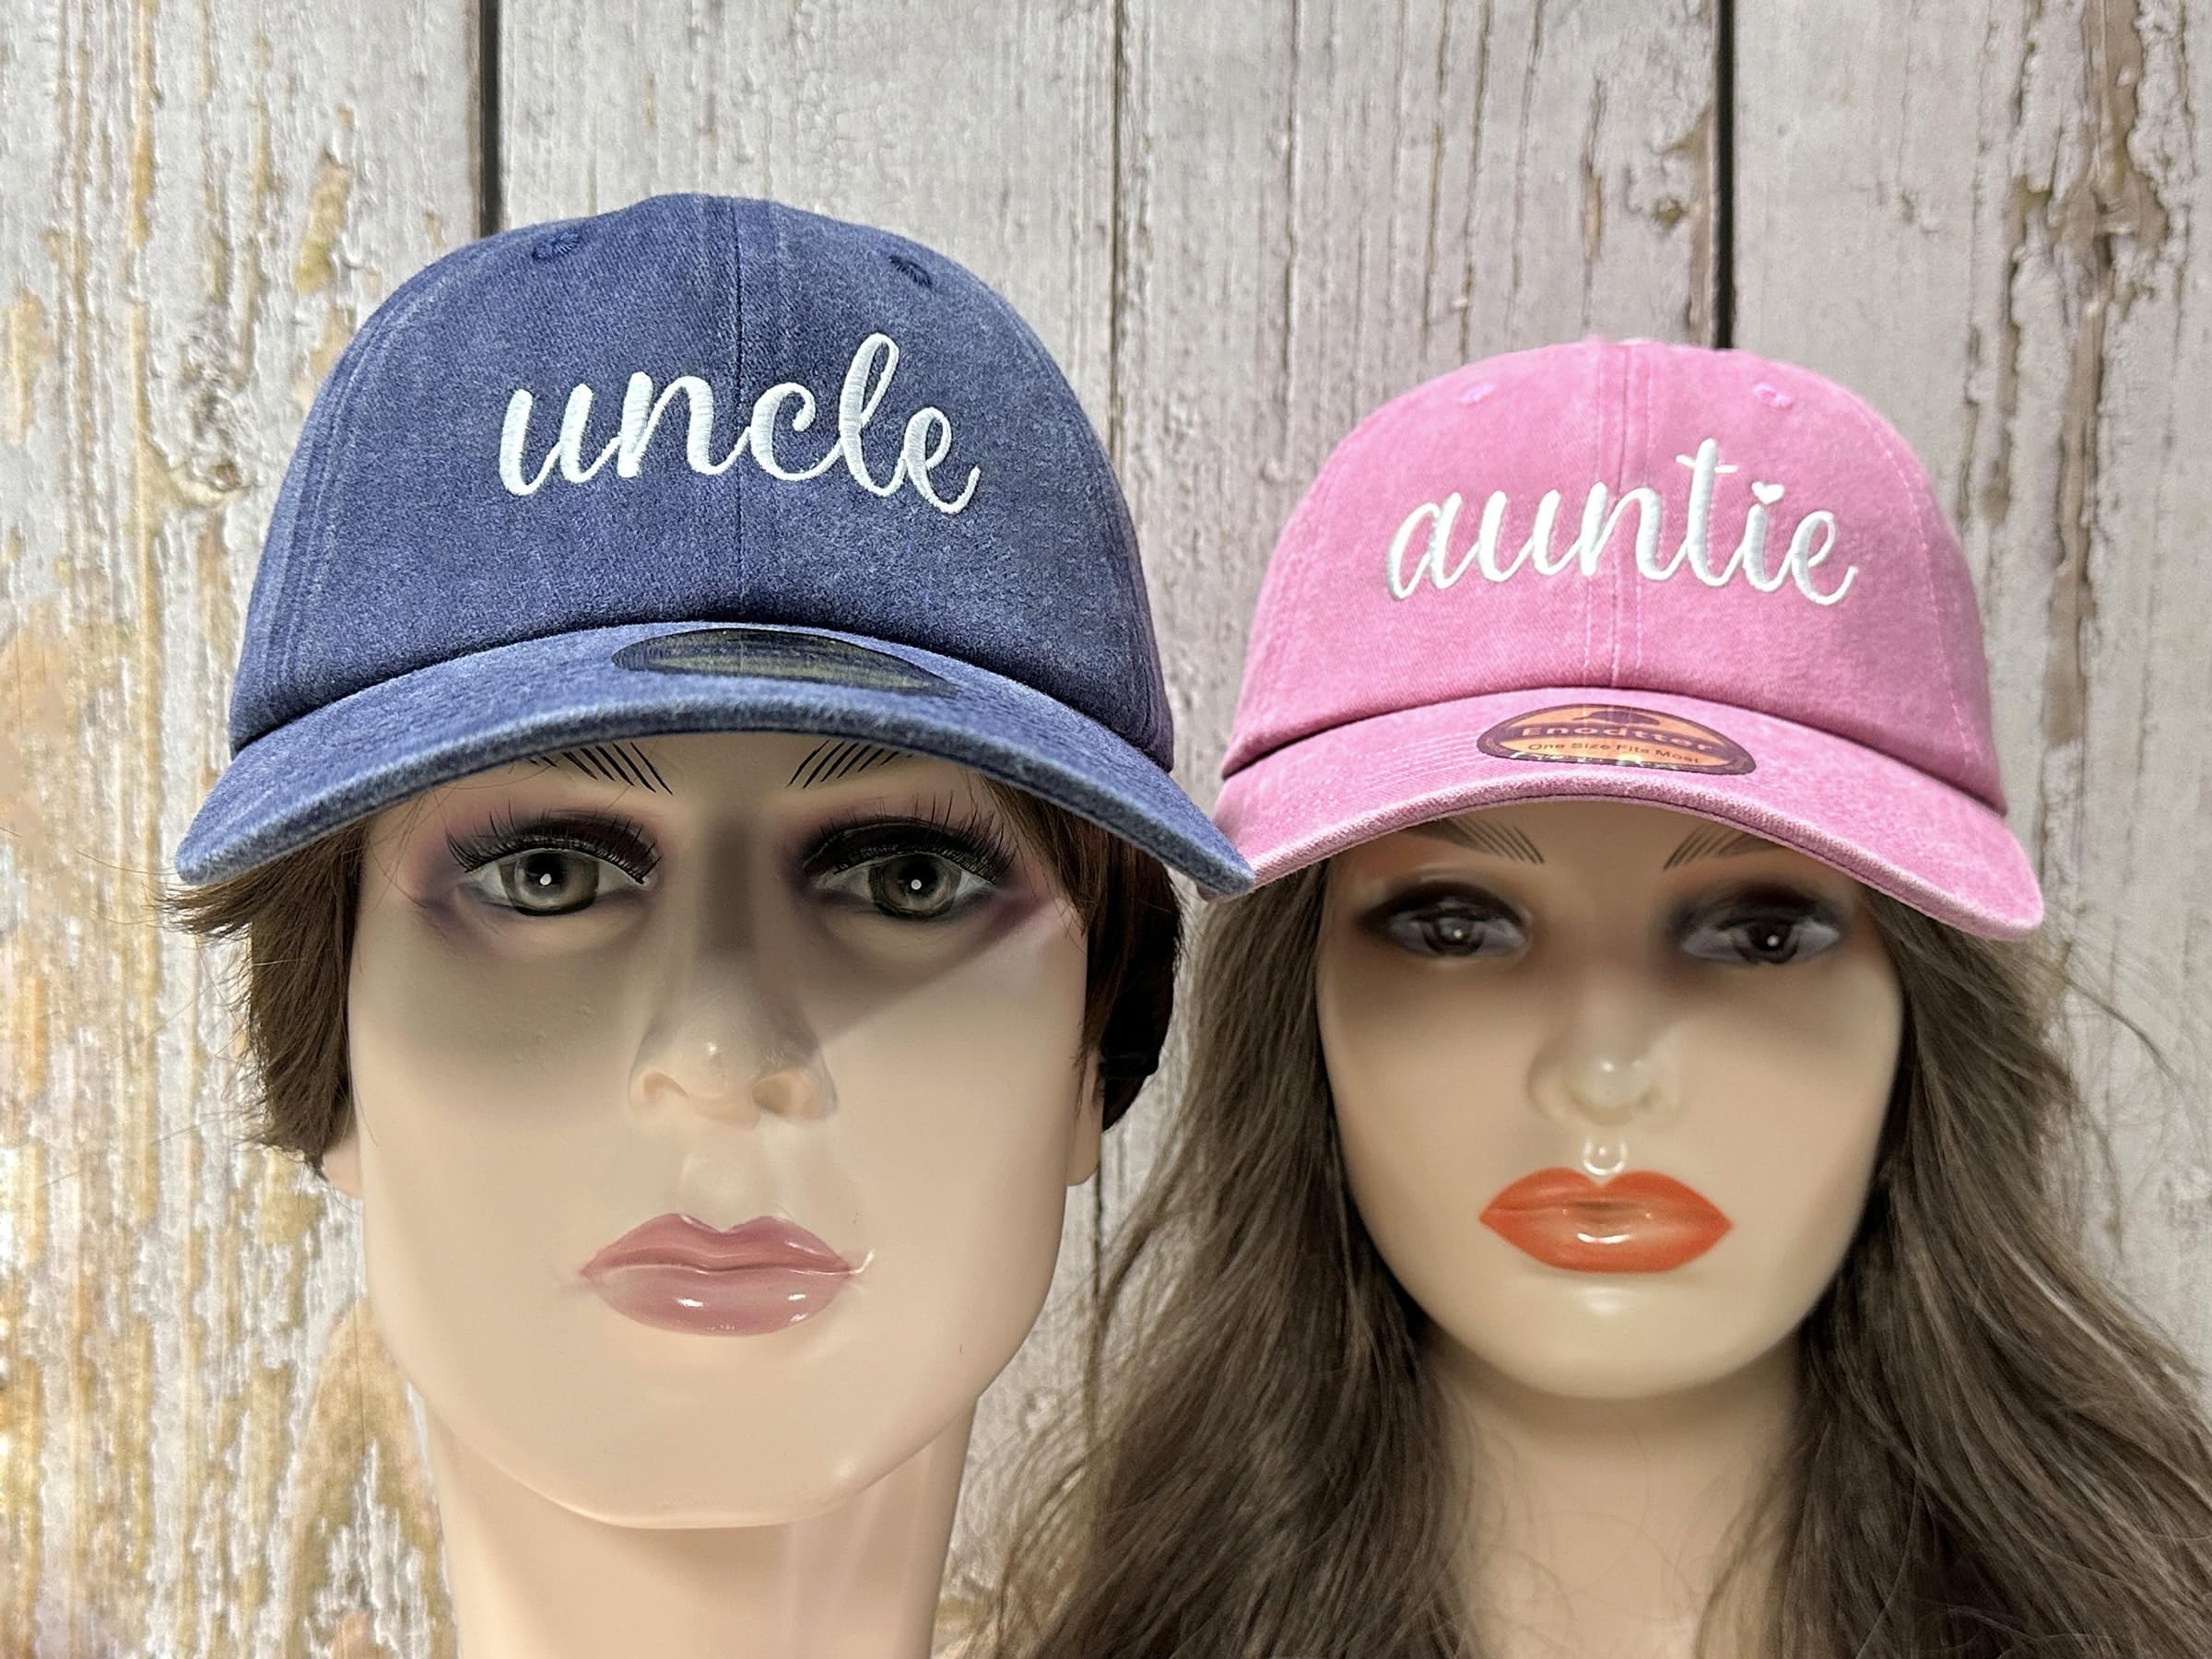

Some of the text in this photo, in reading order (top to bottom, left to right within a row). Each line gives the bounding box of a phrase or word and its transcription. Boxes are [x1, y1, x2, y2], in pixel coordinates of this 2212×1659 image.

[499, 333, 981, 514] uncle
[1386, 437, 1860, 606] auntie
[1527, 743, 1566, 751] One
[1571, 742, 1611, 750] Size
[1616, 744, 1651, 754] Fits
[1654, 749, 1700, 764] Most
